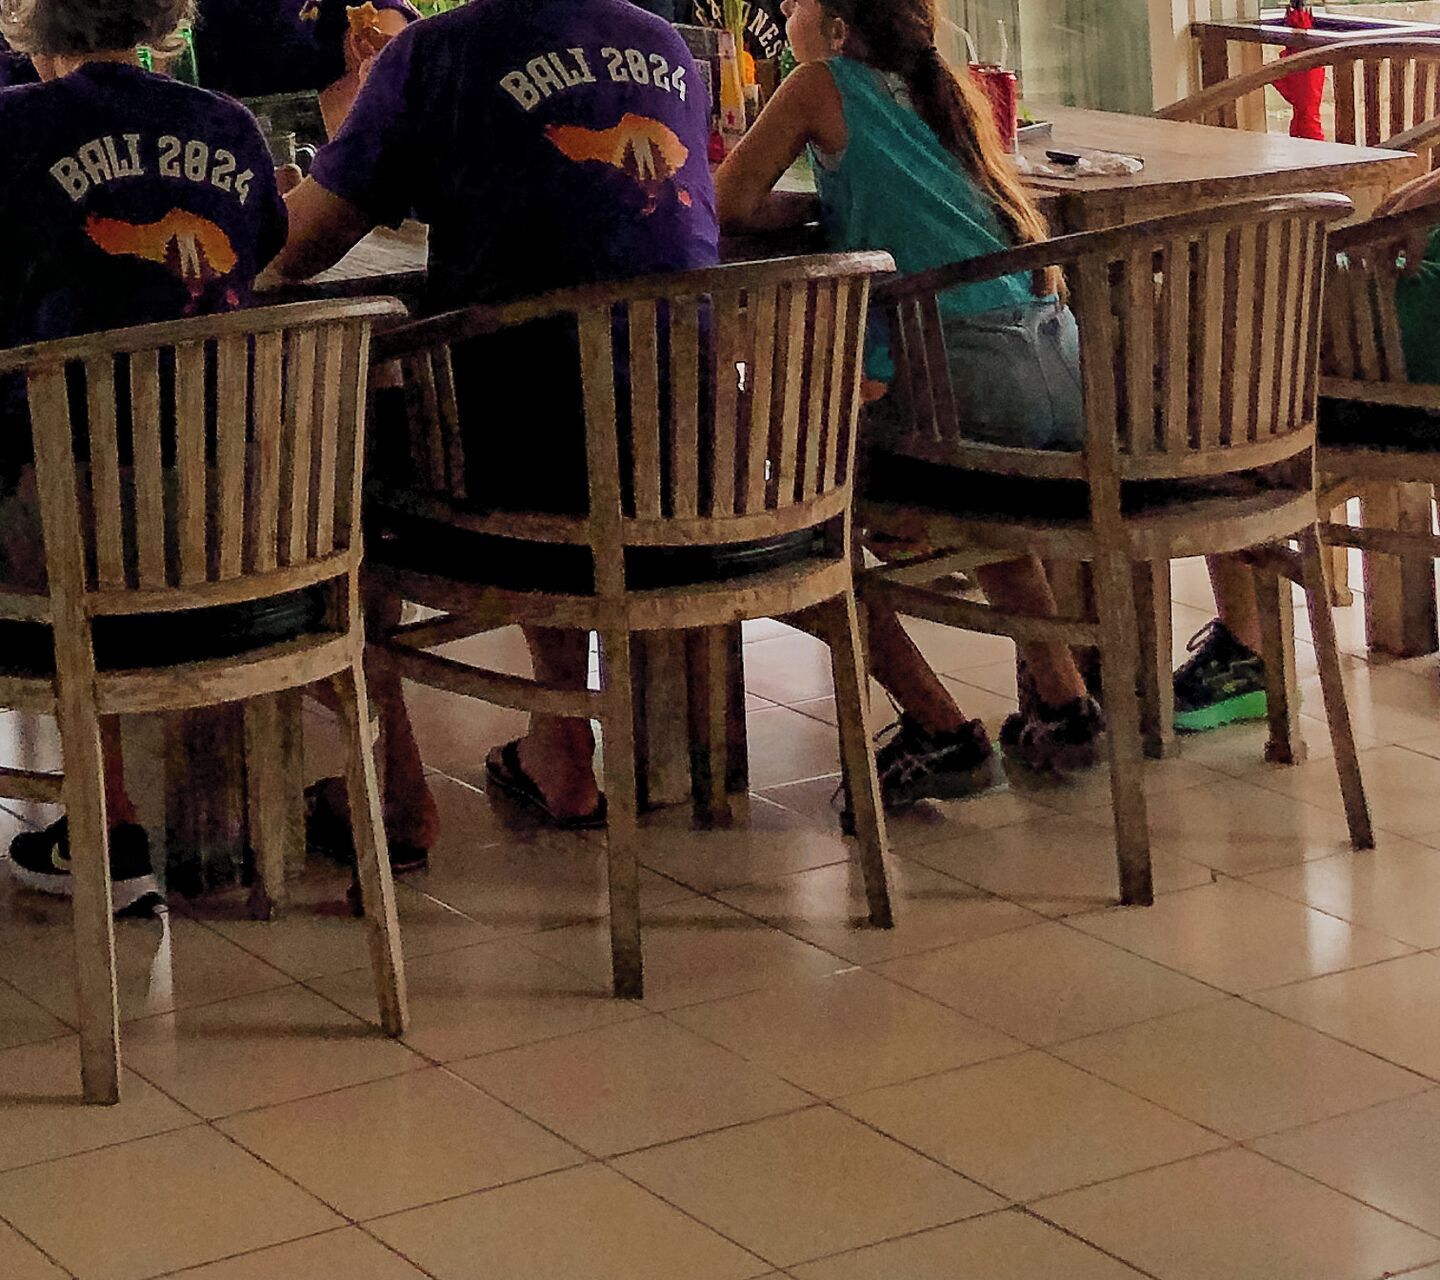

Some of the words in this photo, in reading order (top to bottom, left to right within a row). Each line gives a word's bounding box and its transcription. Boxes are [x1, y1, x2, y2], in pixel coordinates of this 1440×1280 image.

[499, 47, 597, 112] BALI
[601, 46, 687, 102] 2024
[49, 133, 145, 202] BALI
[158, 135, 255, 206] 2024
